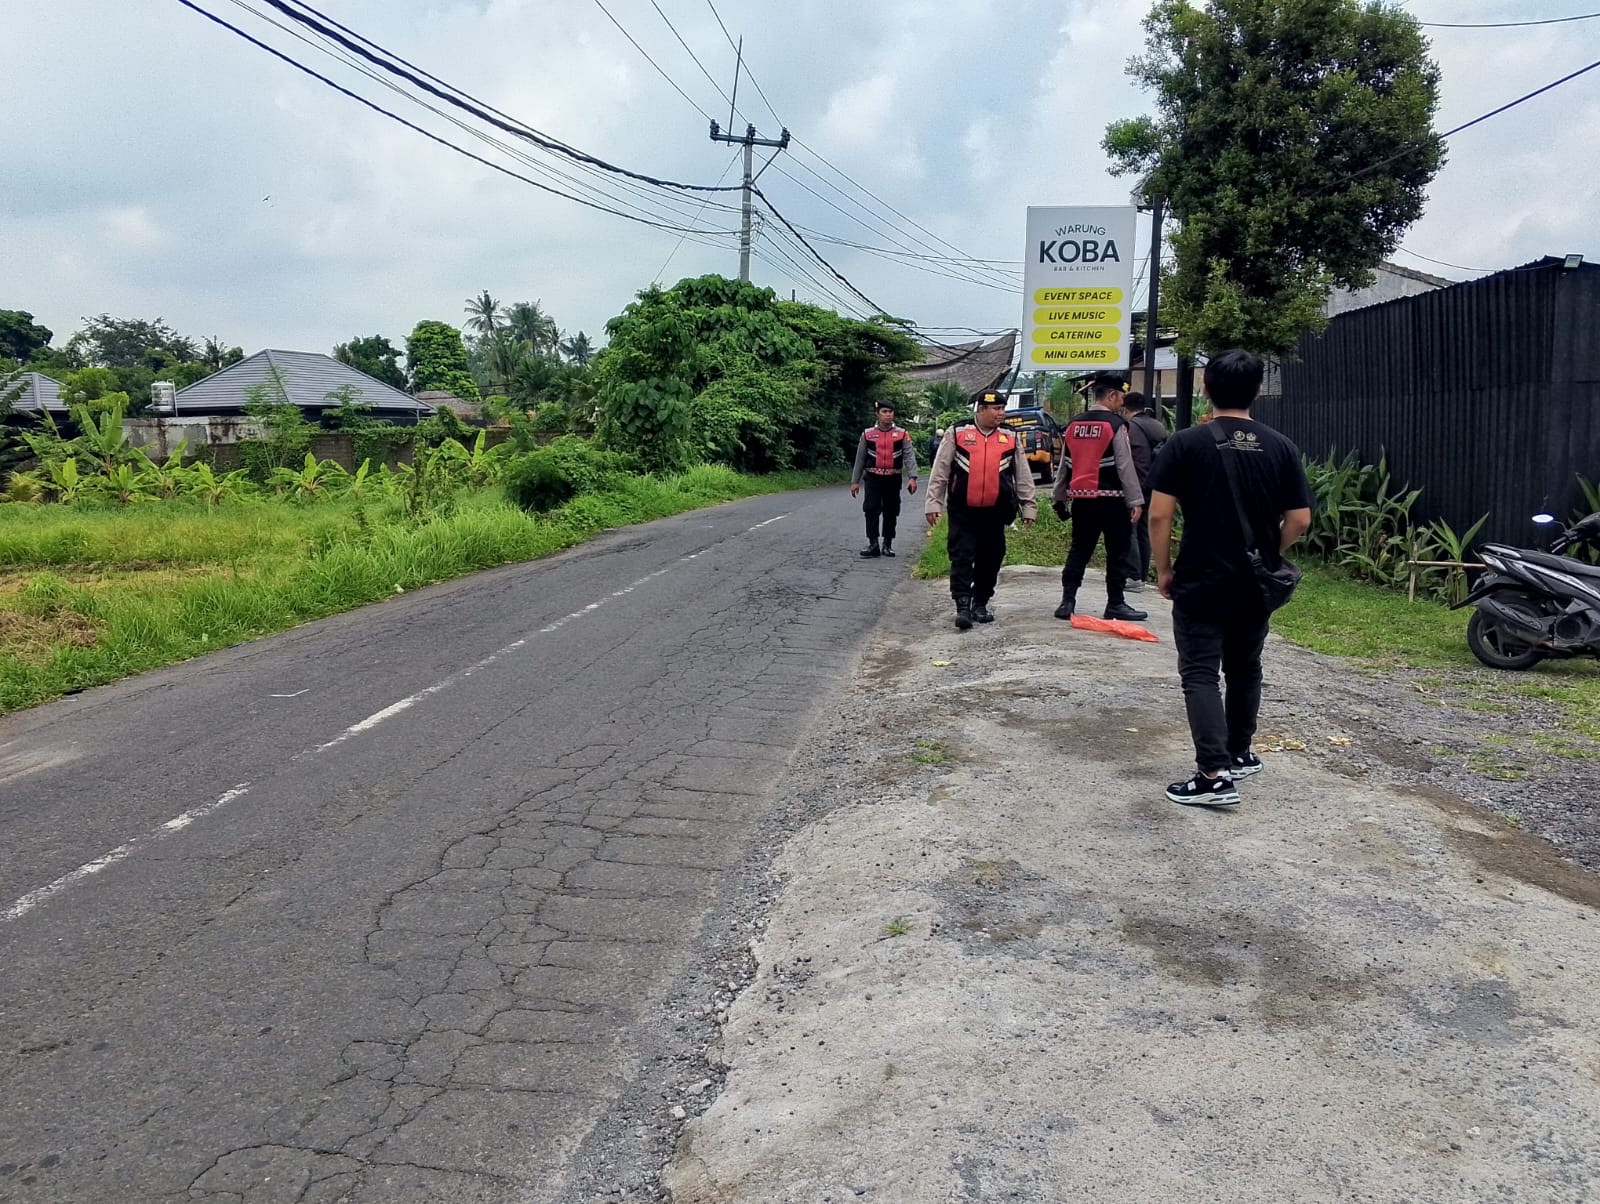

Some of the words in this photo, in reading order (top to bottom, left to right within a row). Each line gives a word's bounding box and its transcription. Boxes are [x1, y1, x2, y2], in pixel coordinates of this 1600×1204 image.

[1055, 224, 1106, 236] WARUNG
[1039, 239, 1120, 263] KOBA
[1044, 292, 1076, 301] EVENT
[1078, 291, 1113, 300] SPACE
[1048, 311, 1071, 320] LIVE
[1071, 311, 1106, 320] MUSIC
[1050, 331, 1103, 340] CATERING
[1044, 350, 1068, 359] MINI
[1070, 350, 1107, 359] GAMES
[1073, 425, 1102, 438] POLISI
